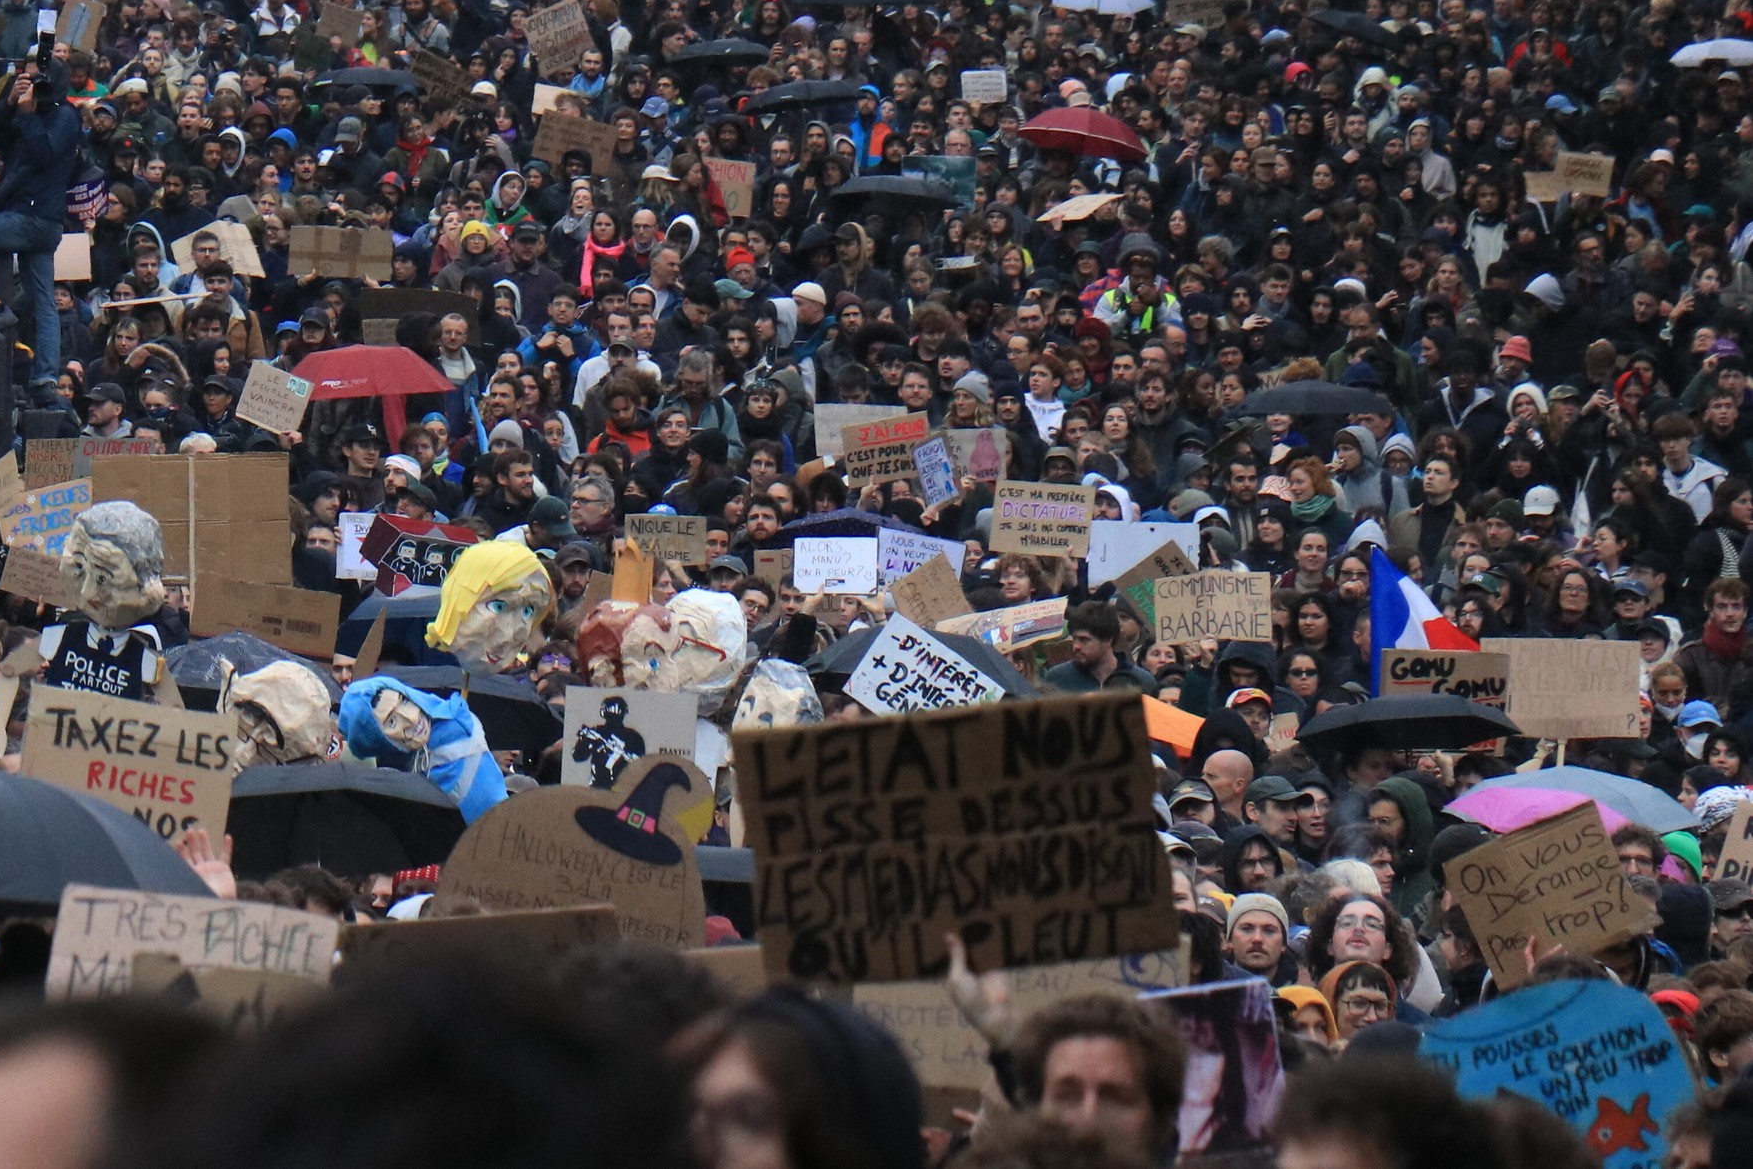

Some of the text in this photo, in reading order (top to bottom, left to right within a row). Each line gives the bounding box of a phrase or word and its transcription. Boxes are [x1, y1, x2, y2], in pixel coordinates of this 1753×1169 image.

[267, 374, 279, 385] LE
[249, 392, 296, 414] VAINCRA
[893, 418, 926, 437] PEUR
[847, 442, 907, 464] C'EST POUR
[851, 466, 875, 479] QUE
[876, 461, 893, 476] JE
[40, 484, 89, 508] KEUFS
[999, 487, 1026, 498] C'EST
[1030, 490, 1044, 500] MA
[630, 518, 696, 536] NIQUE LE
[999, 521, 1012, 531] JE
[1041, 523, 1054, 532] PAS
[800, 541, 843, 554] ALORS
[885, 547, 927, 560] ON VEUT
[891, 535, 944, 552] NOUS AUSSI
[797, 568, 812, 578] ON
[1157, 575, 1263, 599] COMMUNISME
[1196, 593, 1217, 609] ET
[1160, 610, 1270, 642] BARBARIE
[1390, 657, 1455, 680] GOMU
[71, 671, 124, 696] PARTOUT
[46, 707, 230, 770] TAXEZ LES
[1002, 699, 1137, 778] NOUS
[86, 760, 196, 805] RICHES
[764, 774, 1132, 855] PISSE DESSUS
[1460, 863, 1507, 895] On
[73, 894, 187, 942] TRÈS
[1486, 931, 1529, 973] pas
[1472, 1022, 1560, 1069] POUSSES
[1512, 1023, 1648, 1081] LE BOUCHON
[1574, 1057, 1618, 1091] PEU
[1624, 1039, 1673, 1073] TROP
